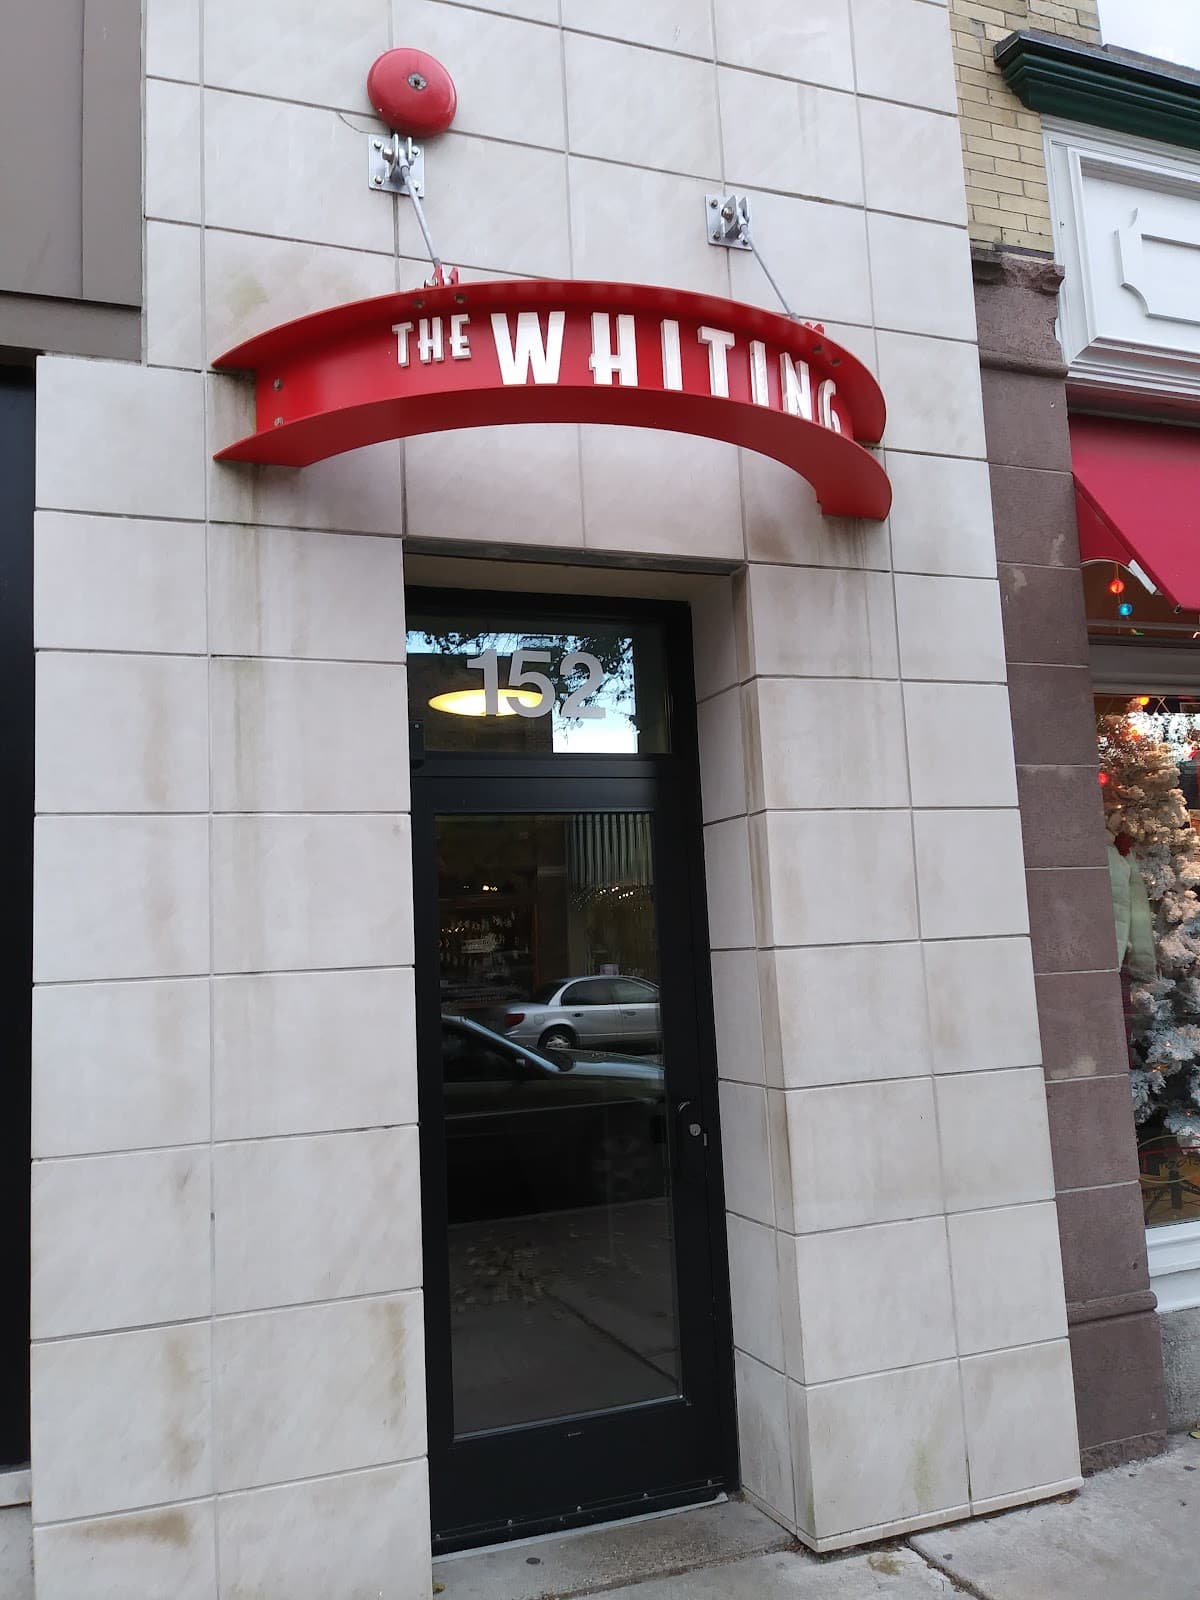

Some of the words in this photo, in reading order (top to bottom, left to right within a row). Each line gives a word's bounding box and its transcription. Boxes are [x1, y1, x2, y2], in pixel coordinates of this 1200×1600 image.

[392, 313, 472, 367] THE
[490, 310, 842, 434] WHITING
[466, 648, 607, 719] 152
